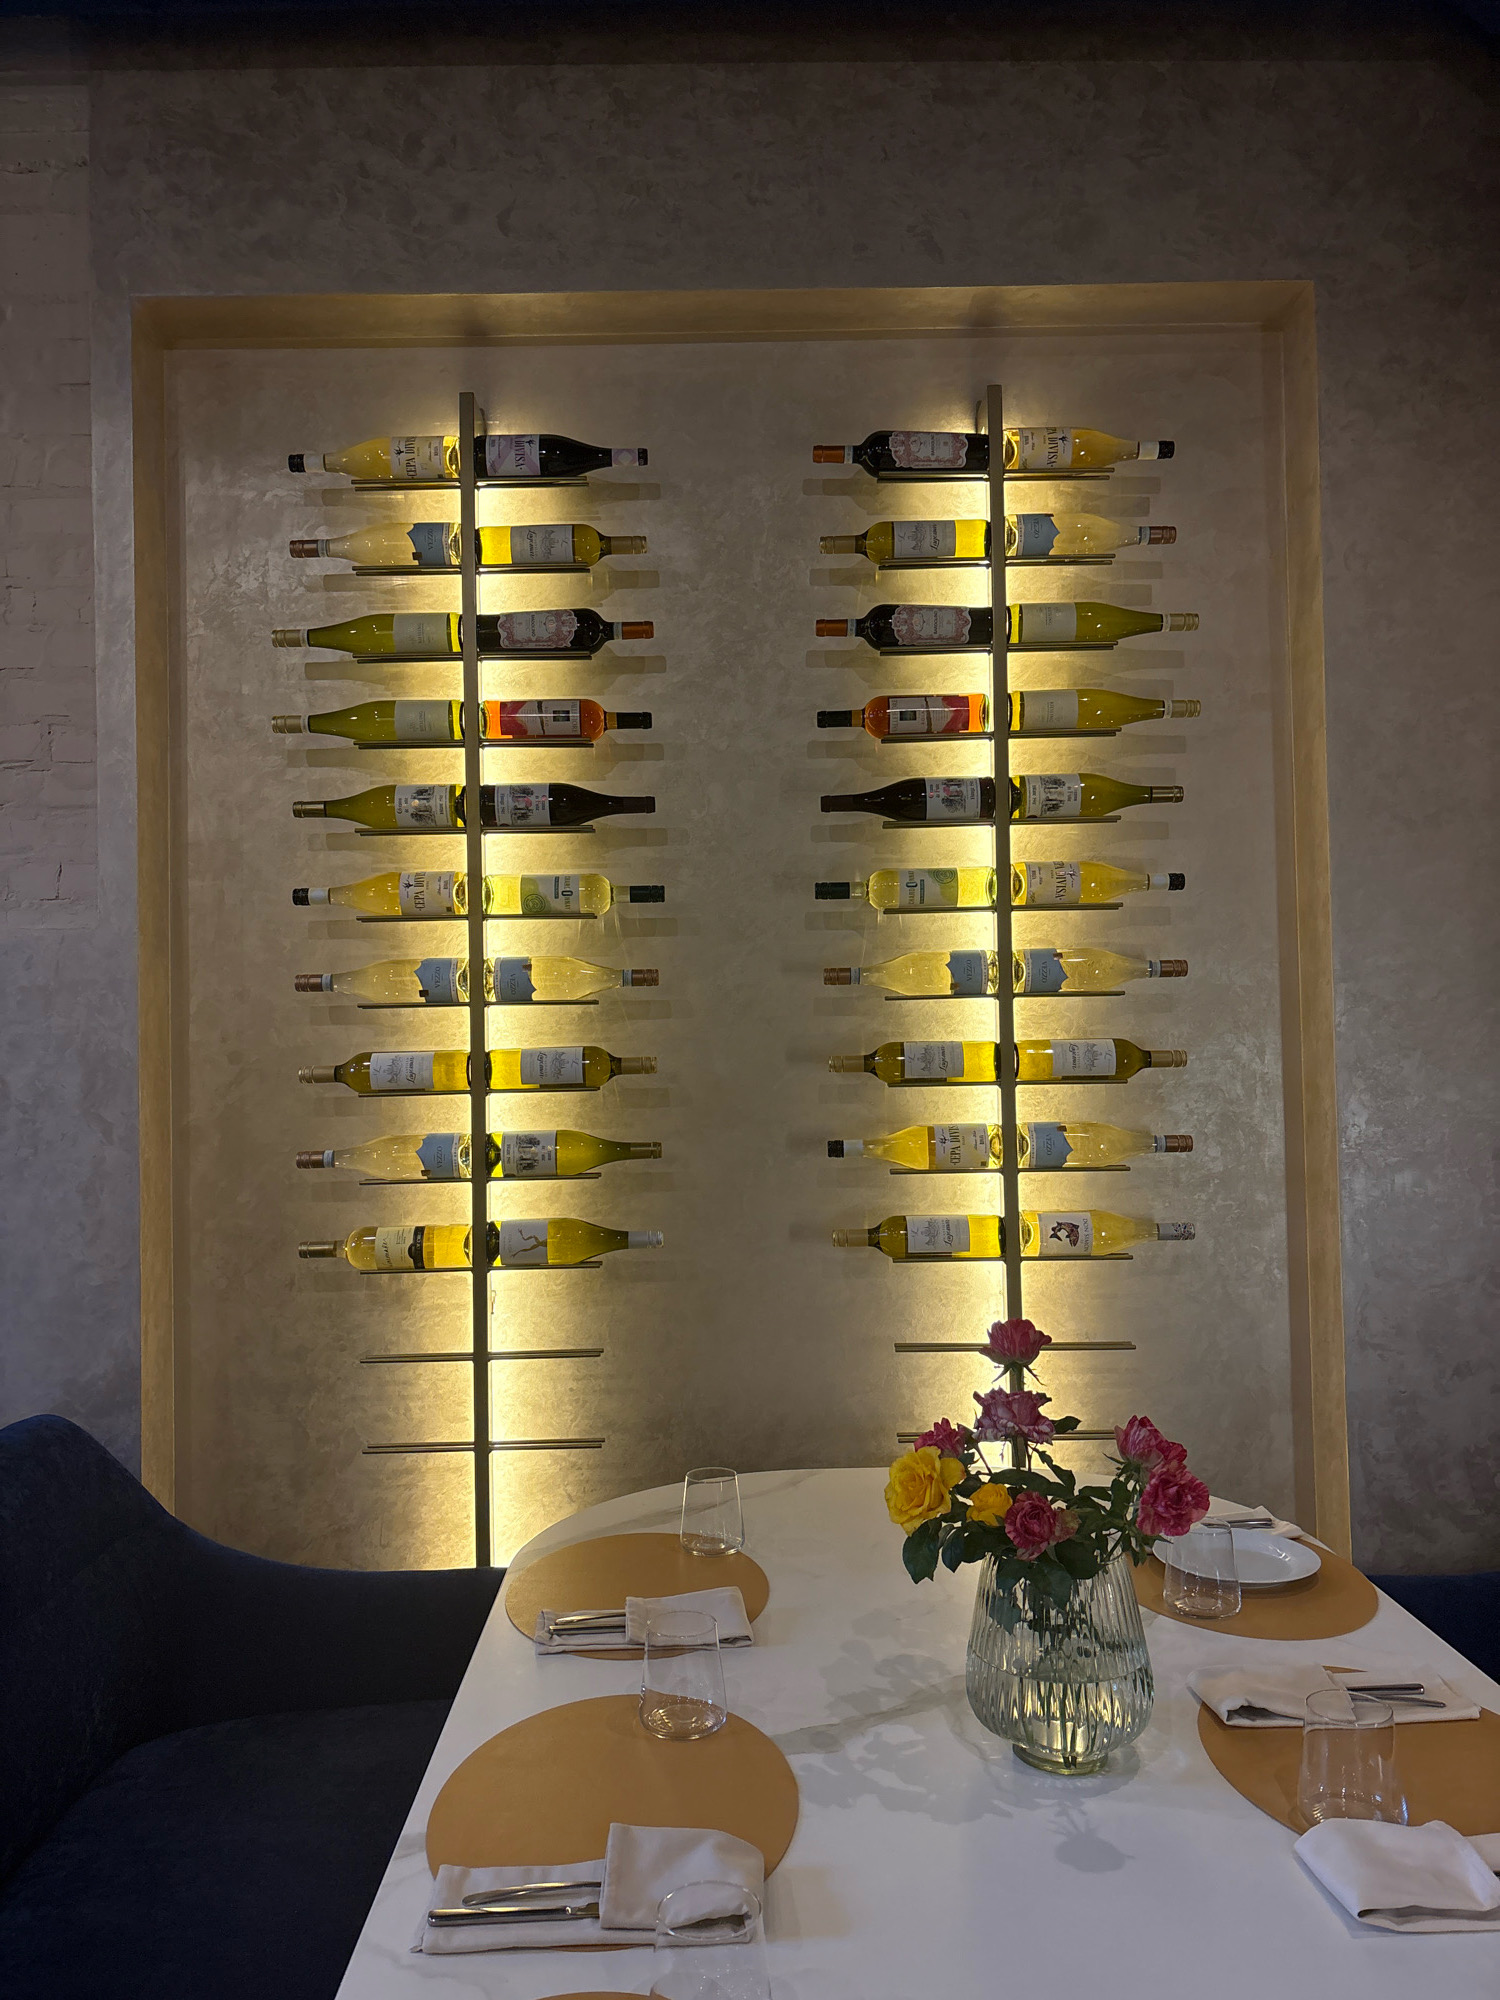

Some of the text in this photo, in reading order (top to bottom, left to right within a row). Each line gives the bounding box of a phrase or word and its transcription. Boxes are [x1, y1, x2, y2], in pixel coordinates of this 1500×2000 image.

[515, 440, 525, 467] DIVISA
[1047, 437, 1058, 464] DIVISA
[405, 457, 417, 477] CEPA
[1055, 871, 1066, 898] DIVISA
[414, 890, 425, 909] CEPA
[950, 1146, 961, 1164] CEPA
